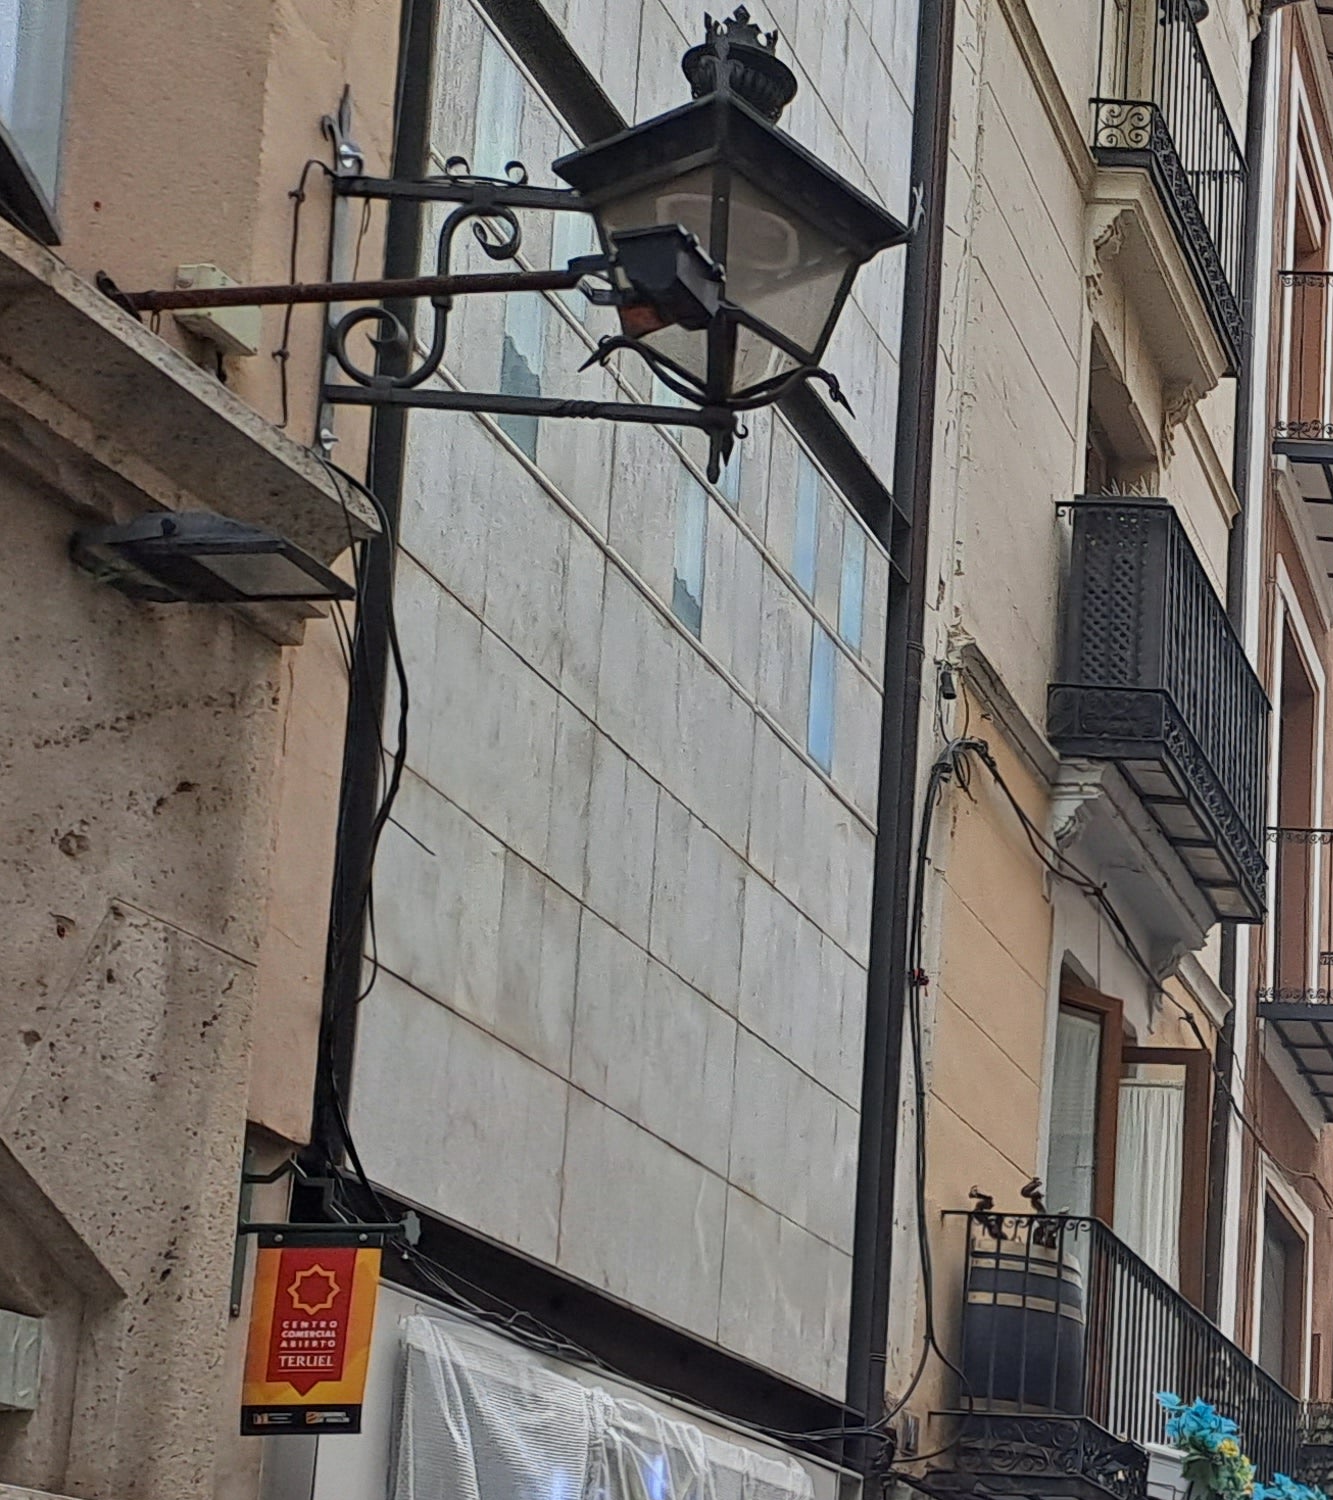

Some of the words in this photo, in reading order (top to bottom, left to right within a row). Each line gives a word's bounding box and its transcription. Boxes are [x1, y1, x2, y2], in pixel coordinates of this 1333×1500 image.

[282, 1320, 338, 1329] CENTRO
[281, 1330, 336, 1338] COMERCIAL
[280, 1340, 336, 1348] ABIERTO
[278, 1355, 334, 1368] TERUEL
